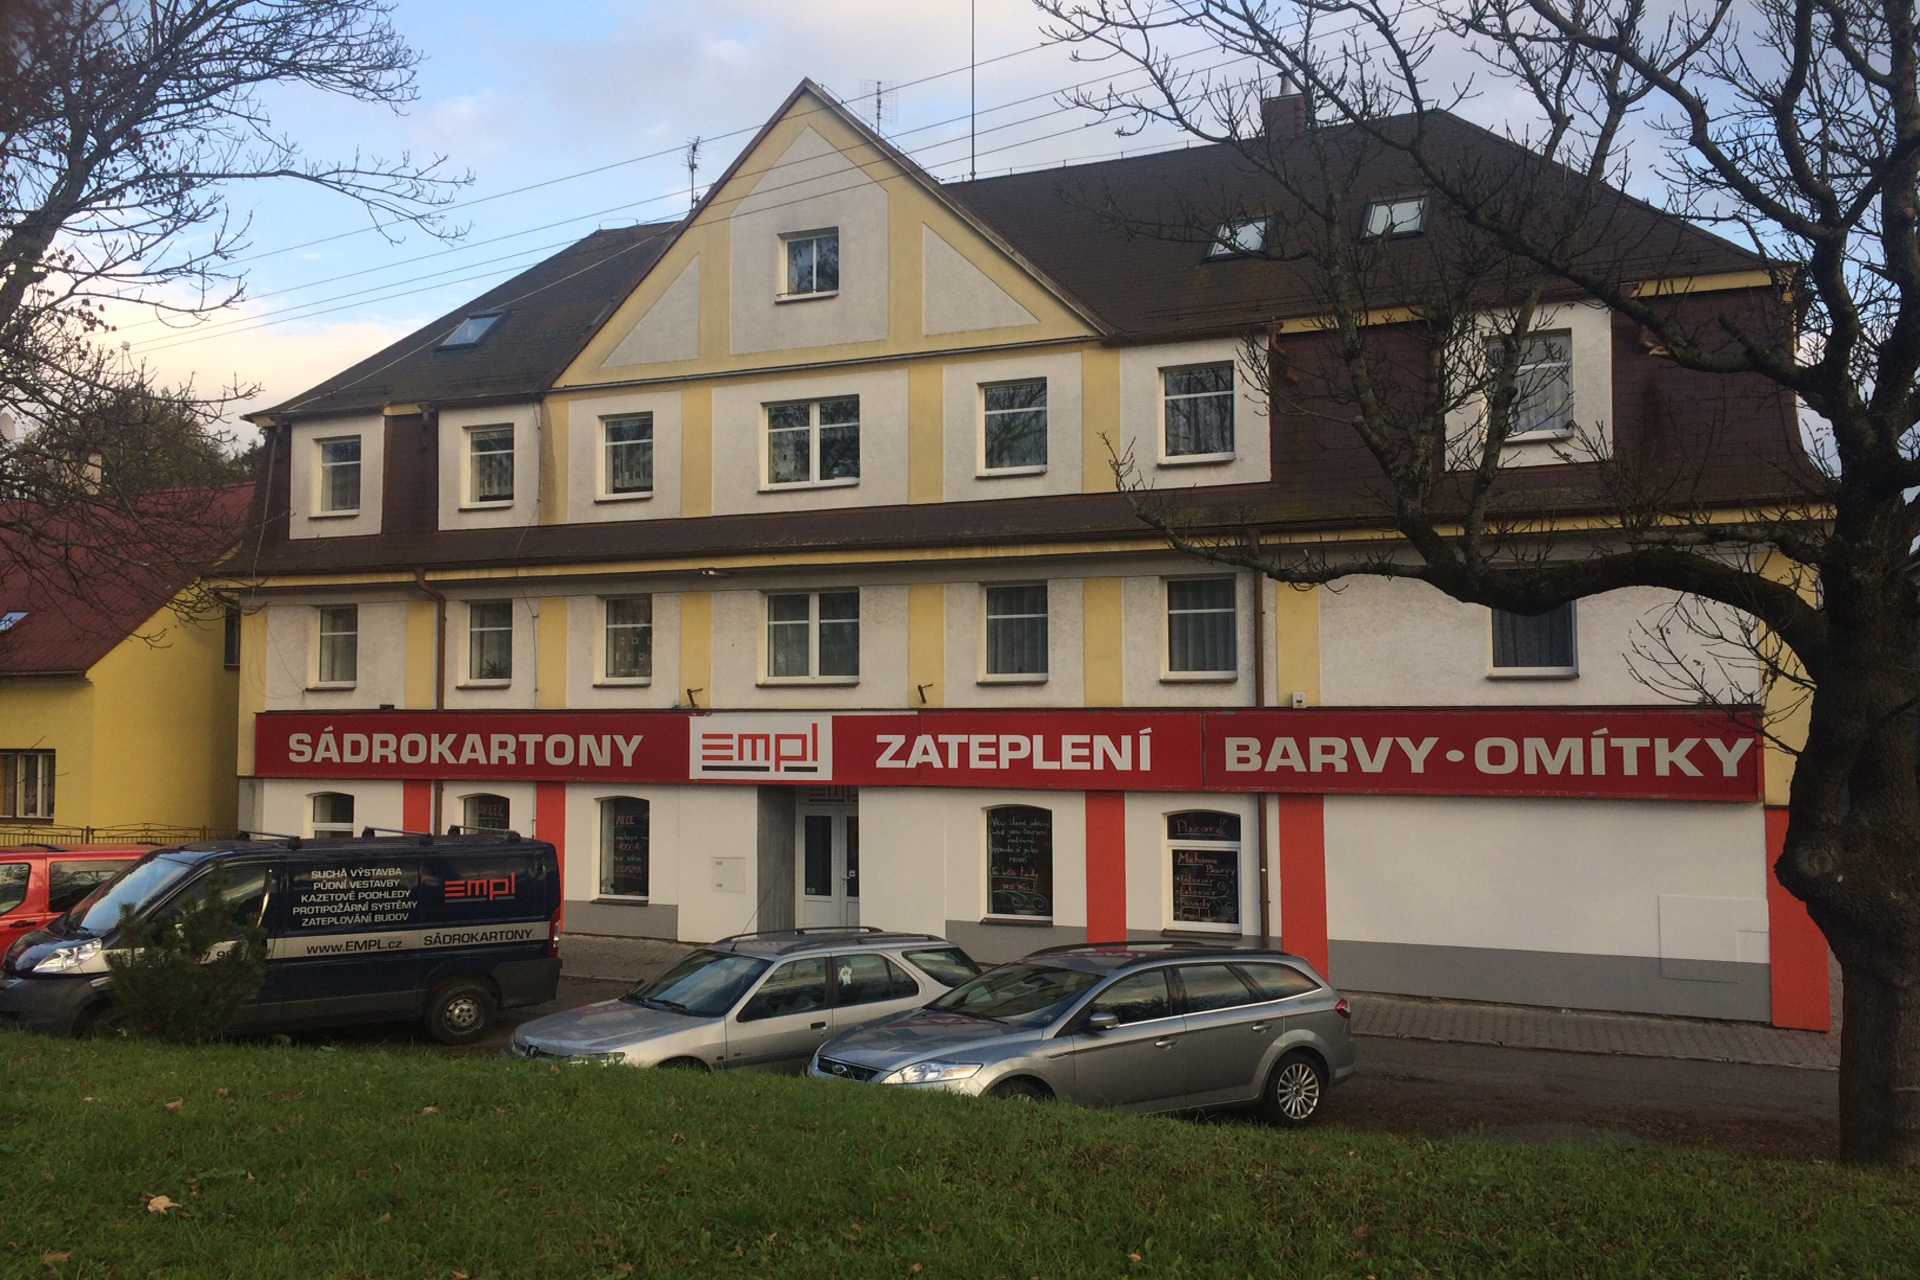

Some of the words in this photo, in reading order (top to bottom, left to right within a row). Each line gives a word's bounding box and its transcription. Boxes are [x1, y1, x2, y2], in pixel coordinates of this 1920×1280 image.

[288, 725, 644, 767] SÁDROKARTONY
[876, 727, 1152, 771] ZATEPLENÍ
[311, 867, 348, 879] SUCHÁ
[350, 867, 402, 877] VÝSTAVBA
[313, 879, 347, 890] PŮDNÍ
[349, 879, 400, 889] VESTAVBY
[301, 891, 355, 903] KAZETOVÉ
[358, 890, 411, 900] PODHLEDY
[292, 901, 368, 915] PROTIPOŽÁRNÍ
[371, 900, 418, 911] SYSTÉMY
[301, 913, 372, 927] ZATEPLOVÁNÍ
[374, 913, 409, 922] BUDOV
[423, 929, 533, 946] SÁDROKARTONY
[306, 940, 403, 954] www.EMPL.cz
